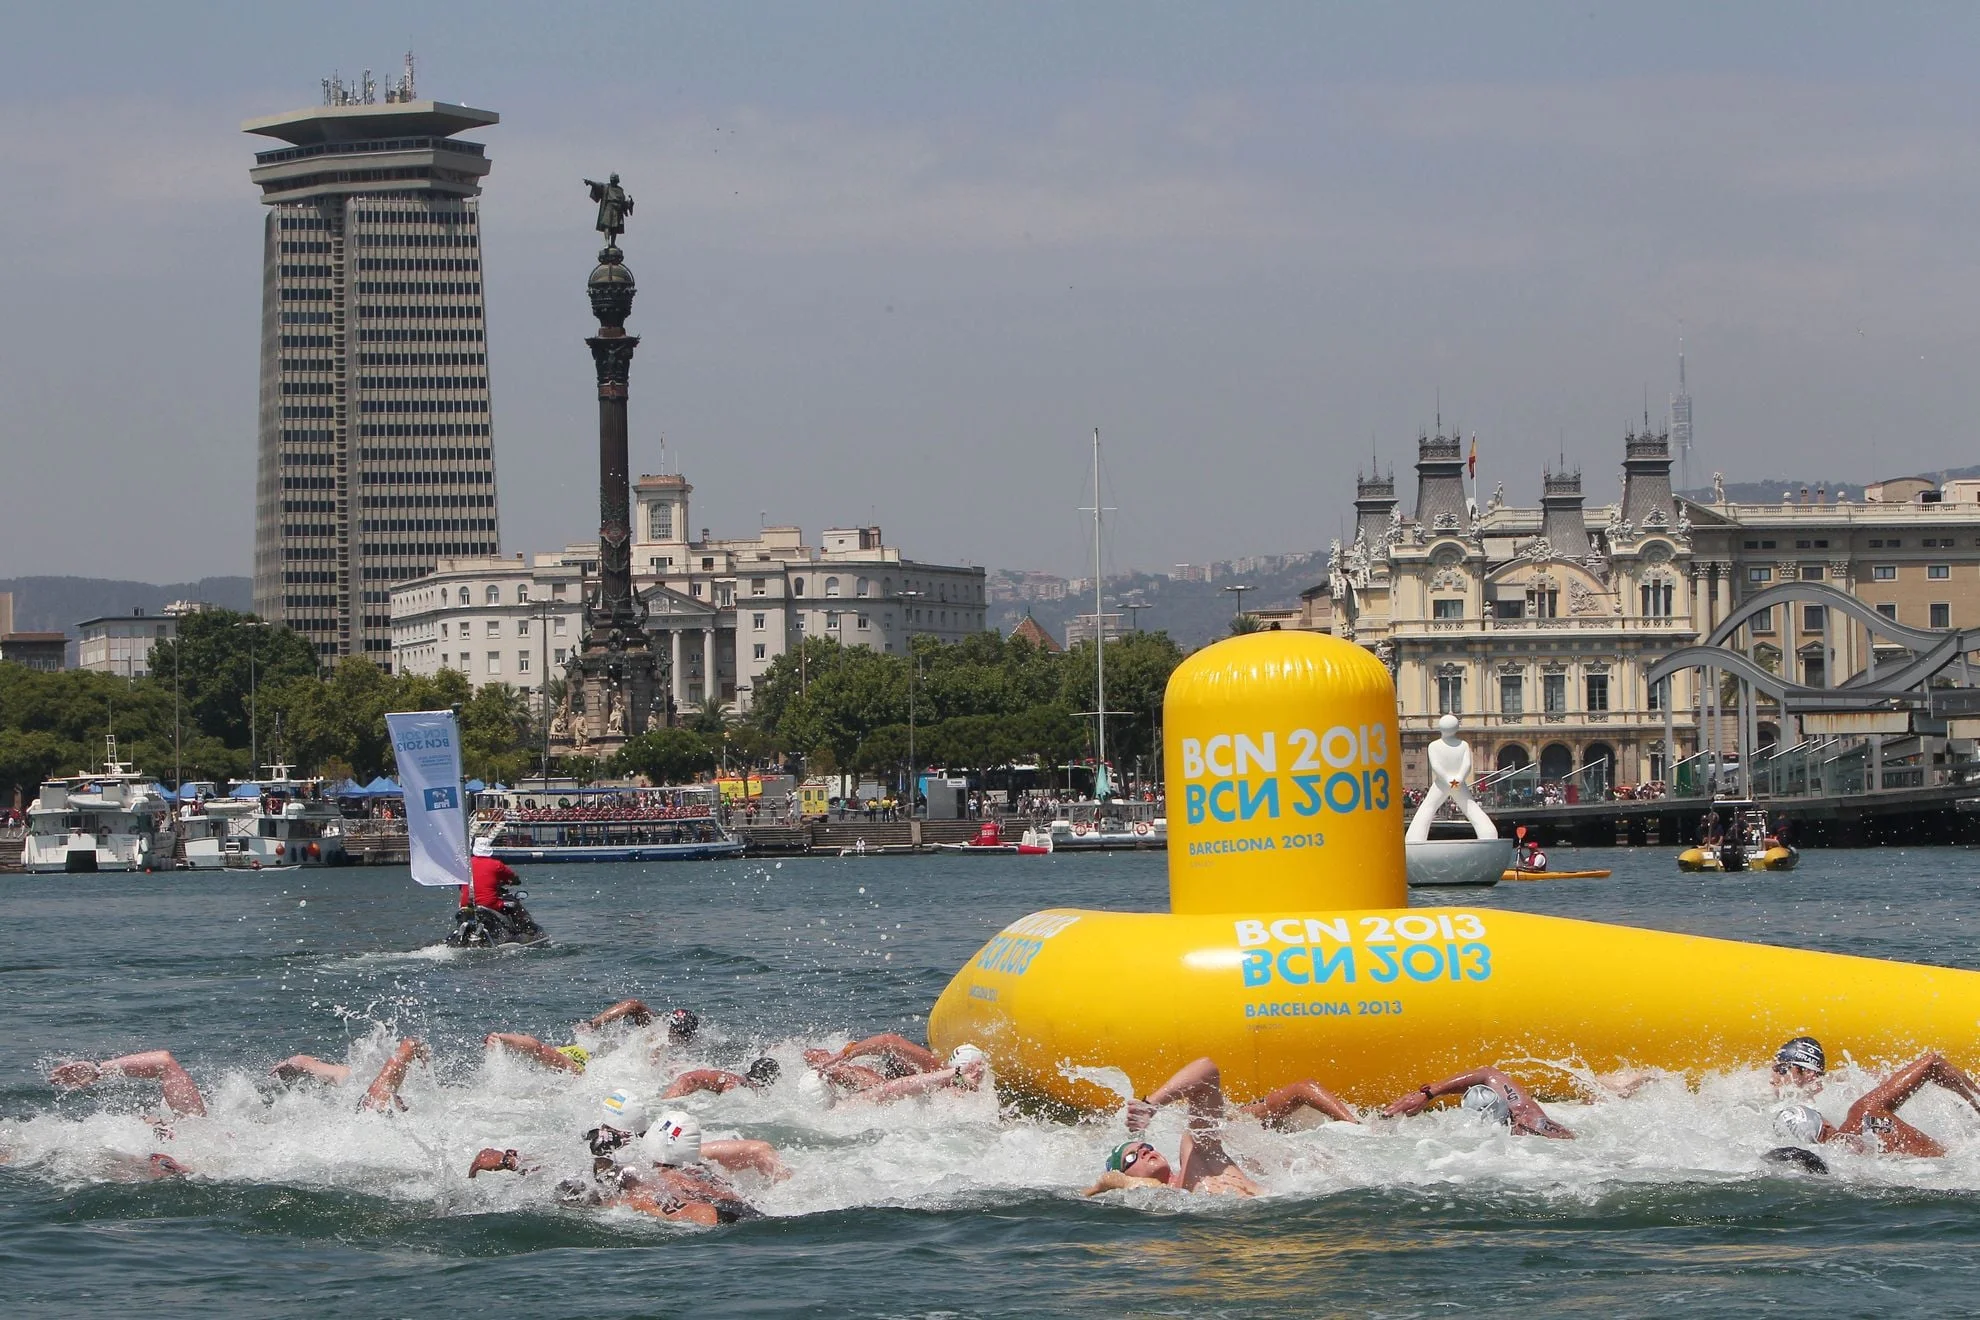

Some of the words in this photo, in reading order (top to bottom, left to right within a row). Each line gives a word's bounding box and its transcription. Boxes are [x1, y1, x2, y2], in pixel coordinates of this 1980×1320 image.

[397, 740, 424, 752] 2013
[425, 738, 450, 749] BCN
[1182, 732, 1277, 779] BCN
[1287, 723, 1389, 771] 2013
[1189, 836, 1276, 857] BARCELONA
[1281, 832, 1325, 850] 2013
[1234, 919, 1350, 947] BCN
[1363, 913, 1486, 942] 2013
[1245, 1001, 1351, 1018] BARCELONA
[1357, 999, 1403, 1016] 2013
[1794, 1051, 1819, 1067] ISRAEL
